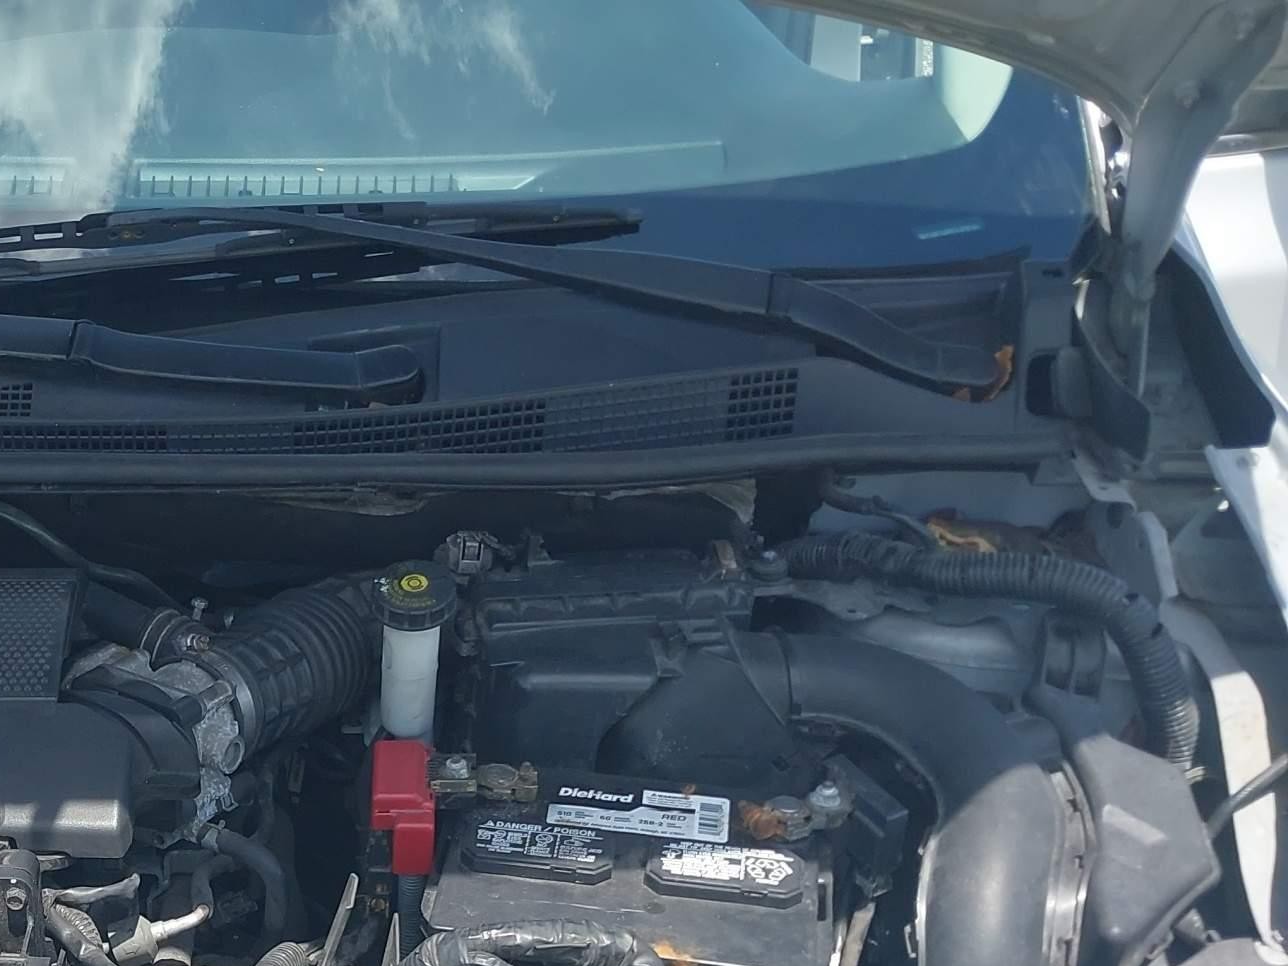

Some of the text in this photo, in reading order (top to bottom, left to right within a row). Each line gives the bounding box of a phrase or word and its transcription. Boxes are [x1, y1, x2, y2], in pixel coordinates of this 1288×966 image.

[558, 787, 634, 803] DieHard
[661, 814, 687, 822] RED
[496, 821, 542, 832] DANGER
[553, 826, 596, 837] POISON
